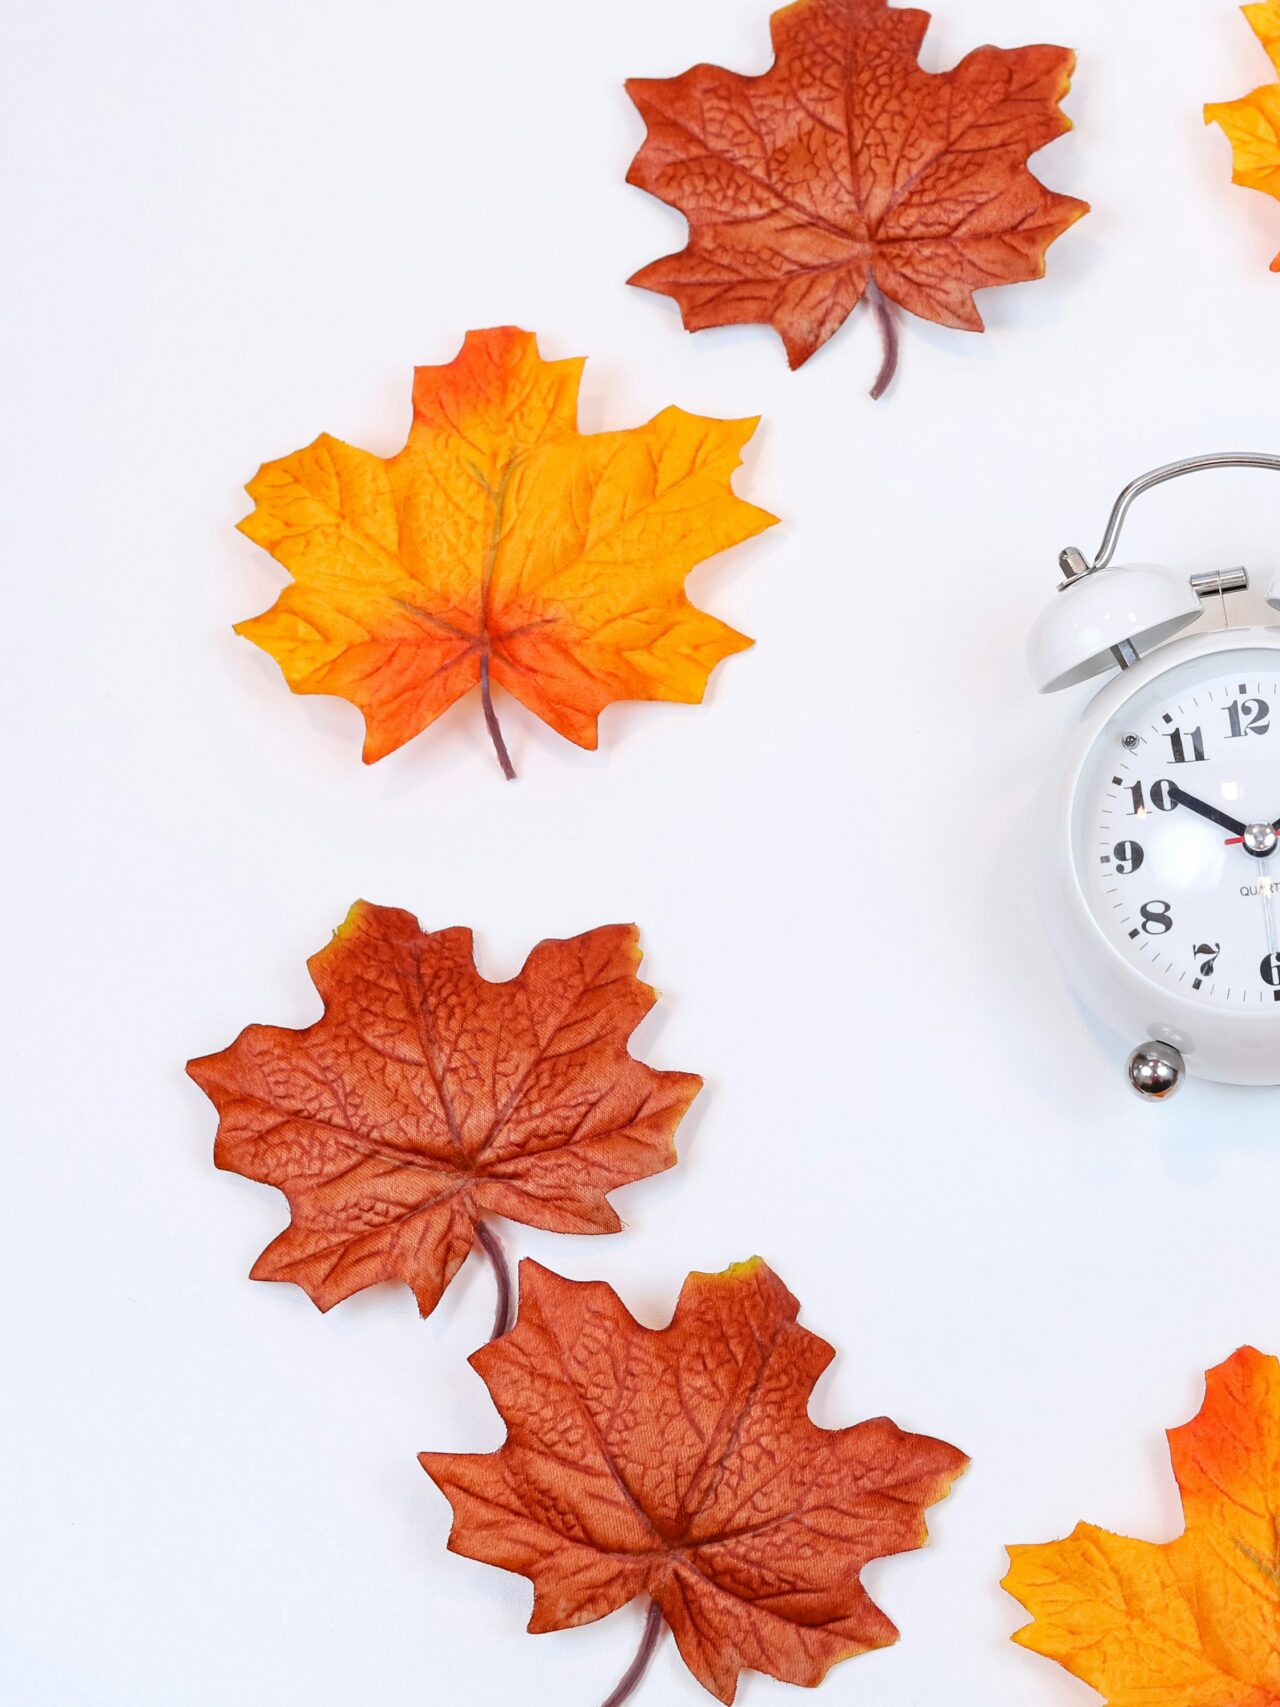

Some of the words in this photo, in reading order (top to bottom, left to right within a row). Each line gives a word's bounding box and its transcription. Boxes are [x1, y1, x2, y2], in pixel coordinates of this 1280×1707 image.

[1220, 698, 1270, 739] 12
[1161, 726, 1211, 764] 11
[1123, 778, 1180, 816] 10
[1113, 840, 1144, 875] 9
[1139, 899, 1173, 935] 8
[1192, 942, 1221, 977] 7
